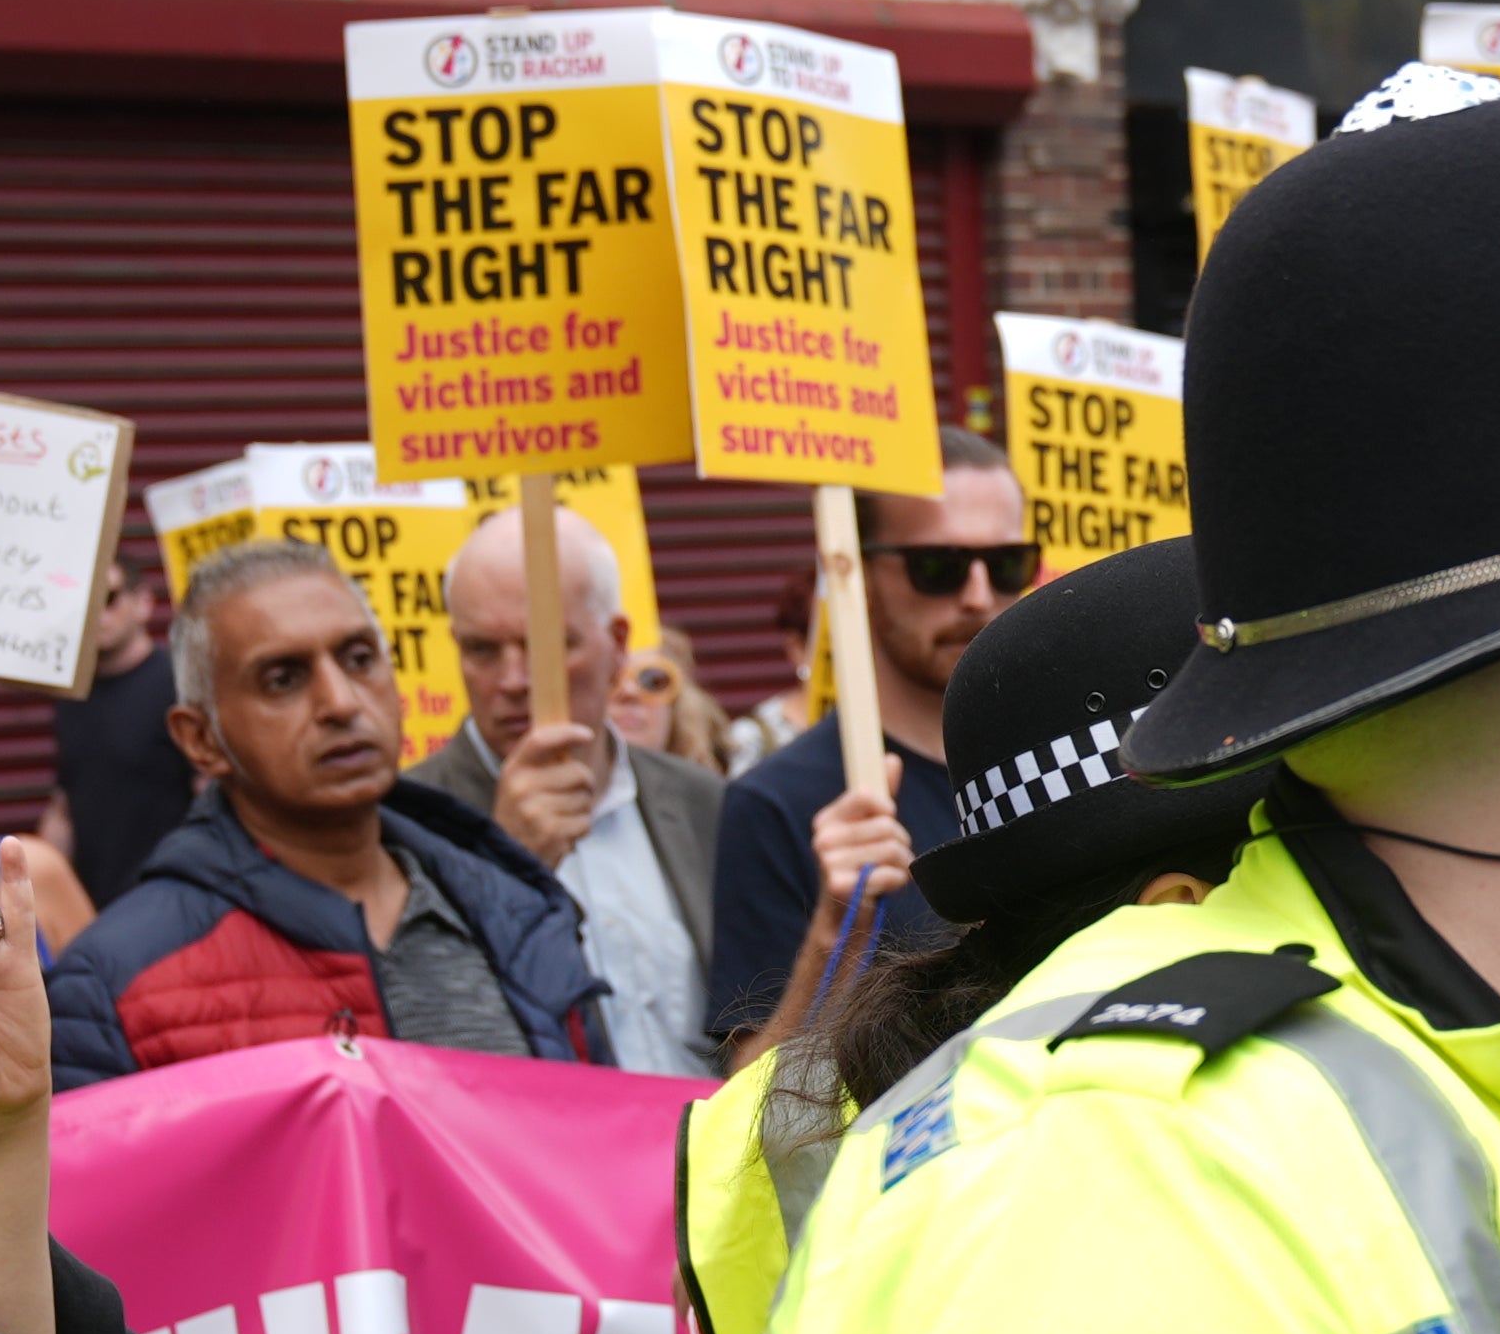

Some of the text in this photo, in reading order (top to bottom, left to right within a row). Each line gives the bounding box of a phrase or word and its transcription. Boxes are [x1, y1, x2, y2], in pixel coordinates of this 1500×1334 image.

[485, 31, 594, 57] STAND UP
[488, 55, 605, 80] TO RACISM
[767, 41, 842, 75] STAND UP
[770, 68, 851, 103] TO RACISM
[383, 103, 558, 169] STOP
[692, 99, 824, 169] STOP
[387, 166, 653, 238] THE FAR
[696, 166, 894, 254] THE FAR
[392, 240, 590, 308] RIGHT
[705, 237, 855, 310] RIGHT
[396, 311, 625, 363] Justice for
[714, 310, 882, 370] Justice for
[397, 358, 642, 412] victims and
[716, 366, 899, 422] victims and
[1028, 383, 1134, 443] STOP
[400, 417, 600, 465] survivors
[720, 420, 876, 467] survivors
[1029, 440, 1187, 510] THE FAR
[280, 514, 399, 562] STOP
[1032, 497, 1155, 552] RIGHT
